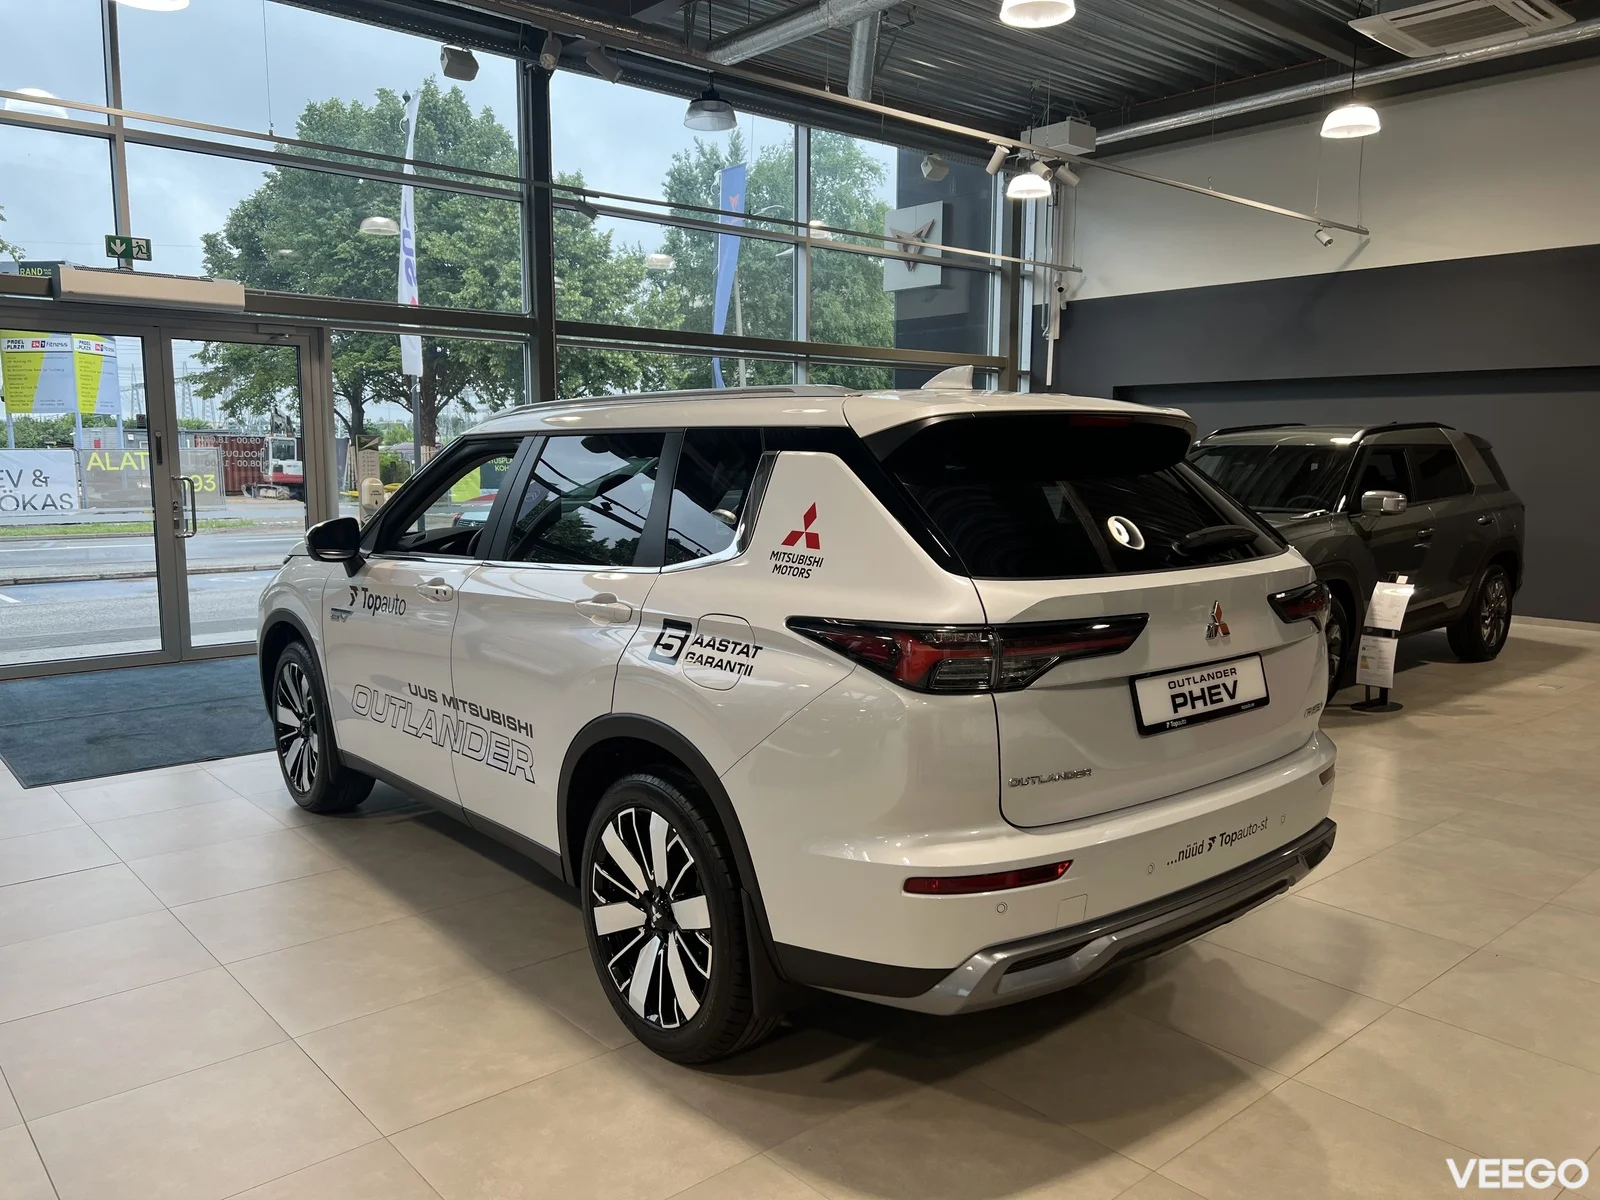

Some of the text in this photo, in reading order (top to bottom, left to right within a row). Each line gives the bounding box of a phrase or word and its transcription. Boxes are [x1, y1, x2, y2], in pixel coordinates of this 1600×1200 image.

[32, 469, 49, 488] &
[769, 550, 824, 568] MITSUBISHI
[772, 563, 812, 579] MOTORS
[361, 587, 407, 616] Topauto
[692, 634, 763, 659] AASTAT
[684, 651, 754, 677] GARANTII
[1168, 667, 1238, 690] OUTLANDER
[1170, 680, 1238, 714] PHEV
[408, 683, 534, 738] UUS MITSUBISHI
[351, 684, 536, 784] OUTLANDER
[1008, 768, 1092, 788] OUTLANDER
[1219, 816, 1268, 847] Topauto-st
